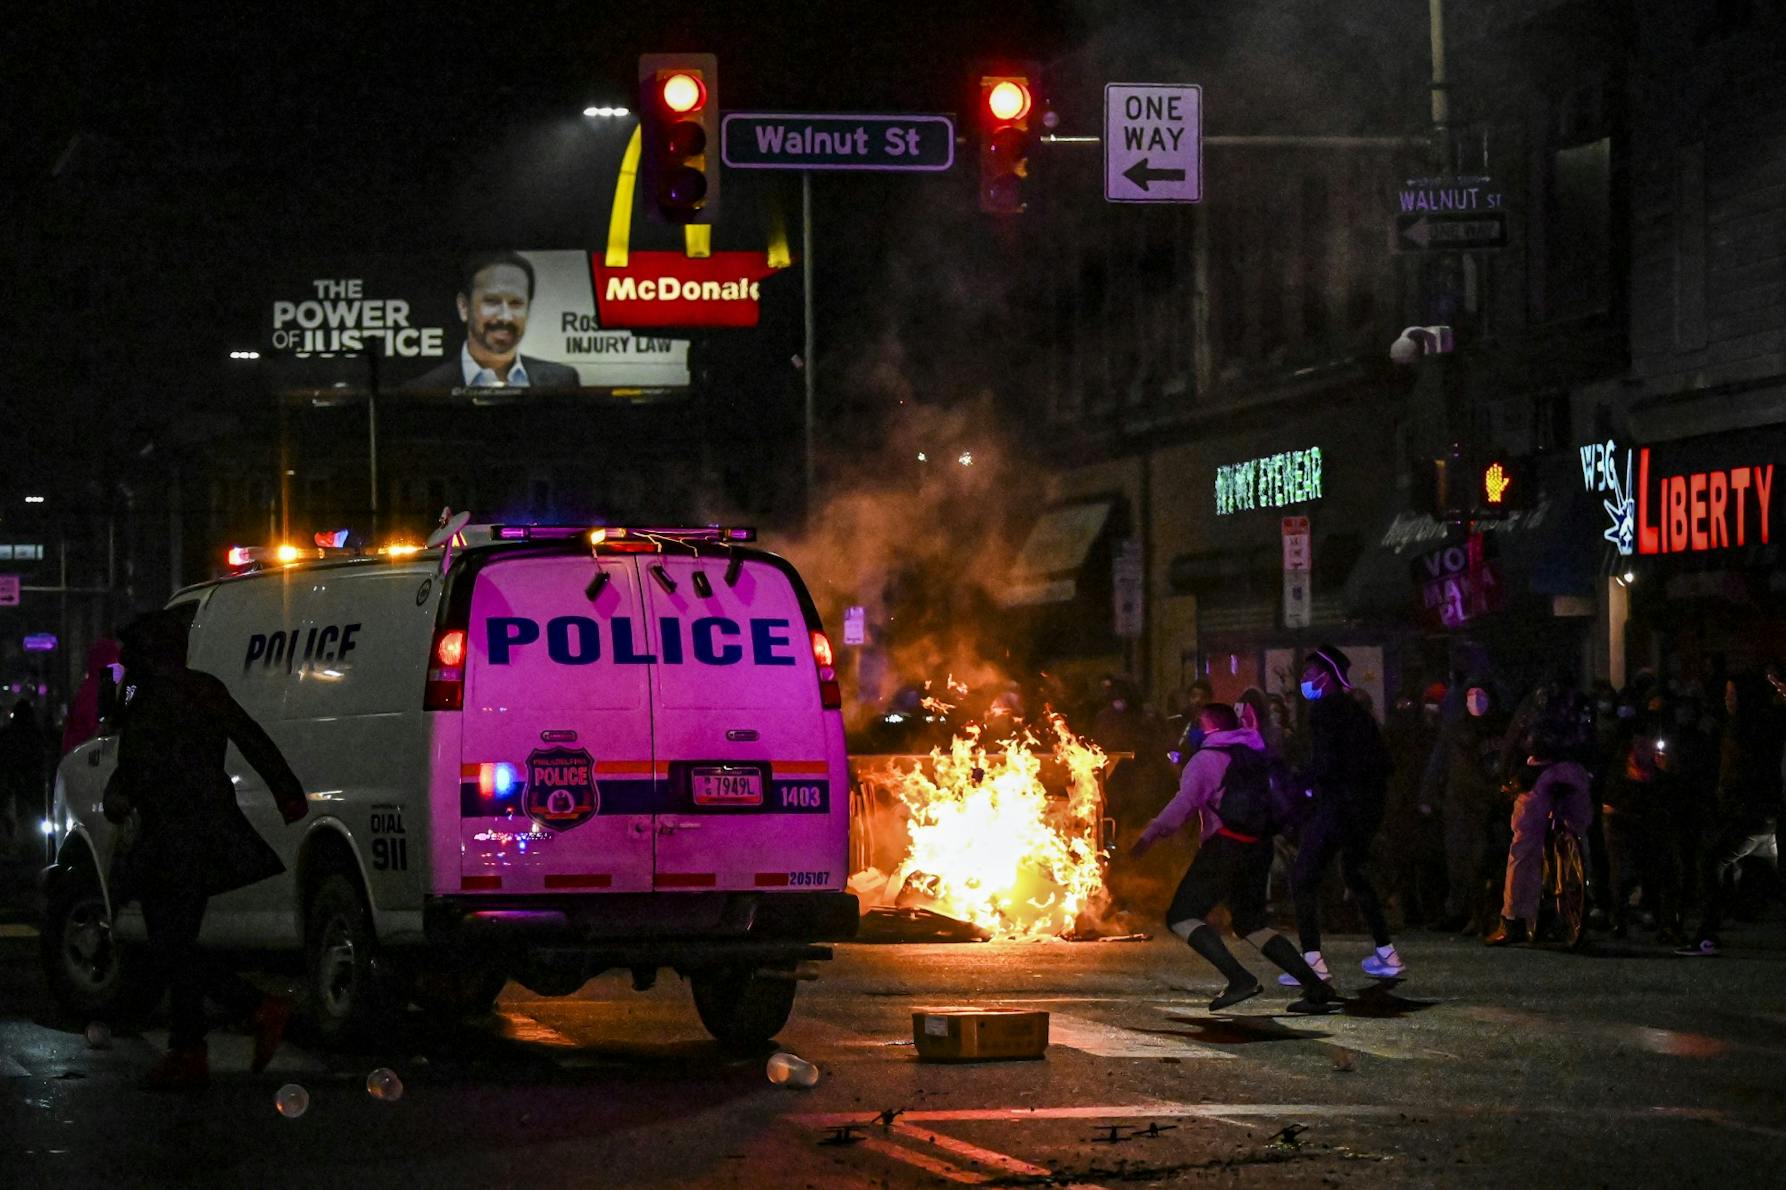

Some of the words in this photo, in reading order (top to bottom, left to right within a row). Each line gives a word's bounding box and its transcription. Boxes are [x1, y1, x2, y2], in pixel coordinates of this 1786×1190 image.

[1126, 95, 1183, 121] ONE
[755, 125, 869, 156] Walnut
[883, 126, 921, 157] St
[1124, 126, 1185, 151] WAY
[1399, 188, 1479, 212] WALNUT
[1486, 193, 1504, 209] ST
[312, 278, 364, 300] THE
[273, 299, 411, 330] POWER
[272, 329, 300, 350] OF
[296, 327, 444, 359] JUSTICE
[566, 337, 629, 354] INJURY
[635, 336, 672, 353] LAW
[1638, 447, 1774, 555] LIBERTY
[243, 623, 362, 676] POLICE
[486, 615, 796, 666] POLICE
[534, 766, 589, 787] POLICE
[781, 786, 820, 807] 1403
[371, 813, 406, 834] DIAL
[372, 837, 408, 871] 911
[790, 871, 829, 886] 205167
